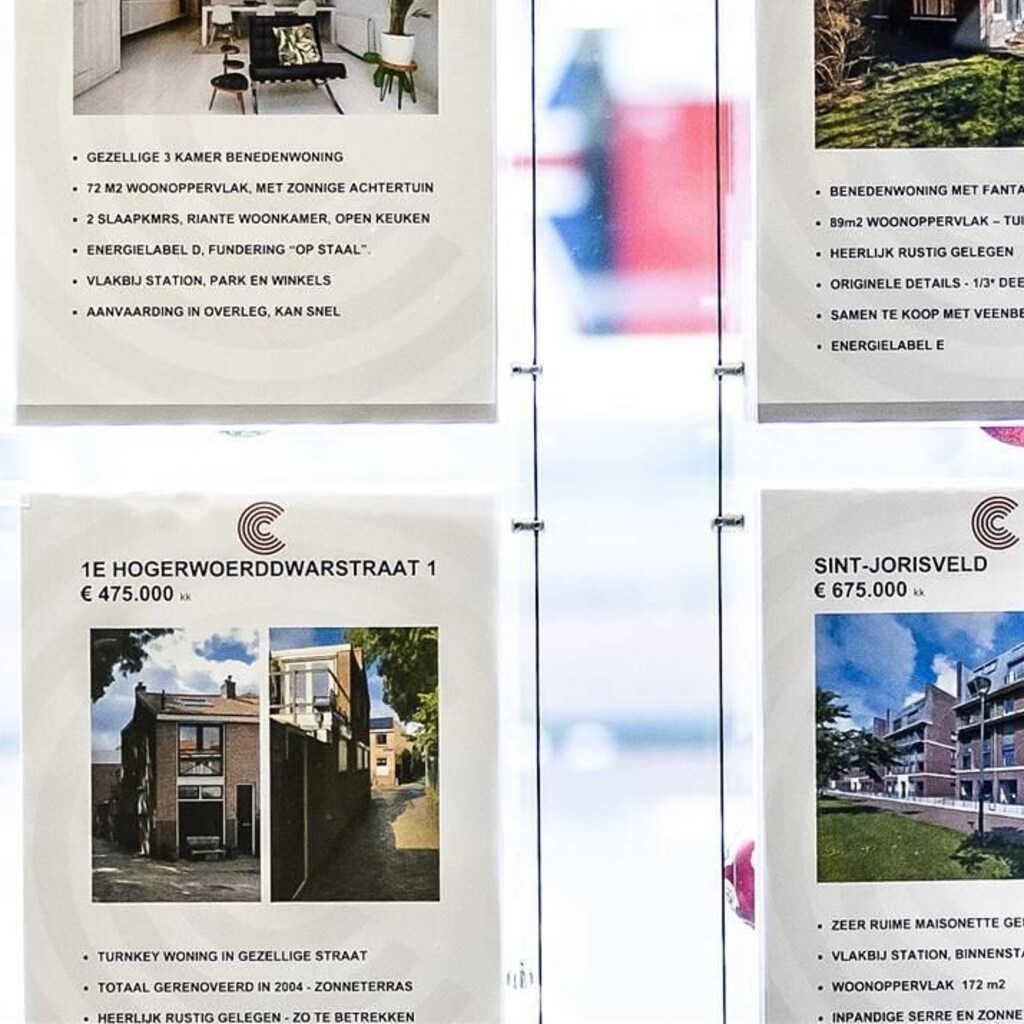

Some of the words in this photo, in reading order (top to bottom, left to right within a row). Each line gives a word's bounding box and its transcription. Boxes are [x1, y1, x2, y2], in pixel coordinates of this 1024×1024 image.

[86, 151, 160, 164] GEZELLIGE
[163, 151, 172, 163] 3
[174, 151, 223, 164] KAMER
[225, 150, 344, 163] BENEDENWONING
[86, 182, 102, 194] 72
[104, 182, 123, 195] M2
[125, 182, 253, 195] WOONOPPERVLAK,
[255, 182, 284, 194] MET
[286, 182, 346, 194] ZONNIGE
[348, 181, 434, 194] ACHTERTUIN
[829, 184, 949, 198] BENEDENWONING
[951, 184, 979, 196] MET
[86, 213, 95, 225] 2
[97, 212, 183, 226] SLAAPKMRS,
[186, 212, 236, 225] RIANTE
[238, 212, 332, 226] WOONKAMER,
[334, 212, 372, 225] OPEN
[375, 212, 431, 225] KEUKEN
[829, 247, 895, 259] HEERLIJK
[897, 246, 948, 259] RUSTIG
[950, 245, 1014, 259] GELEGEN
[86, 274, 143, 287] VLAKBIJ
[145, 274, 207, 288] STATION,
[209, 274, 247, 287] PARK
[249, 274, 269, 287] EN
[271, 274, 332, 287] WINKELS
[86, 305, 185, 318] AANVAARDING
[187, 305, 201, 318] IN
[203, 305, 272, 319] OVERLEG,
[274, 305, 303, 317] KAN
[305, 305, 342, 318] SNEL
[830, 308, 878, 322] SAMEN
[880, 308, 899, 321] TE
[901, 308, 941, 321] KOOP
[942, 307, 971, 320] MET
[830, 339, 933, 352] ENERGIELABEL
[935, 338, 945, 351] E
[81, 560, 107, 578] 1E
[112, 559, 421, 578] HOGERWOERDDWARSTRAAT
[426, 559, 436, 577] 1
[813, 555, 989, 575] SINT-JORISVELD
[79, 584, 93, 603] €
[97, 584, 174, 603] 475.000
[179, 592, 191, 601] kk
[813, 581, 827, 599] €
[831, 580, 908, 599] 675.000
[913, 587, 925, 597] kk
[830, 918, 867, 932] ZEER
[869, 918, 912, 931] RUIME
[914, 917, 1000, 930] MAISONETTE
[96, 950, 160, 963] TURNKEY
[162, 950, 219, 963] WONING
[221, 950, 235, 962] IN
[237, 950, 312, 962] GEZELLIGE
[314, 949, 369, 962] STRAAT
[831, 949, 888, 962] VLAKBIJ
[890, 948, 952, 962] STATION,
[831, 979, 955, 993] WOONOPPERVLAK
[961, 978, 984, 991] 172
[986, 978, 1006, 990] m2
